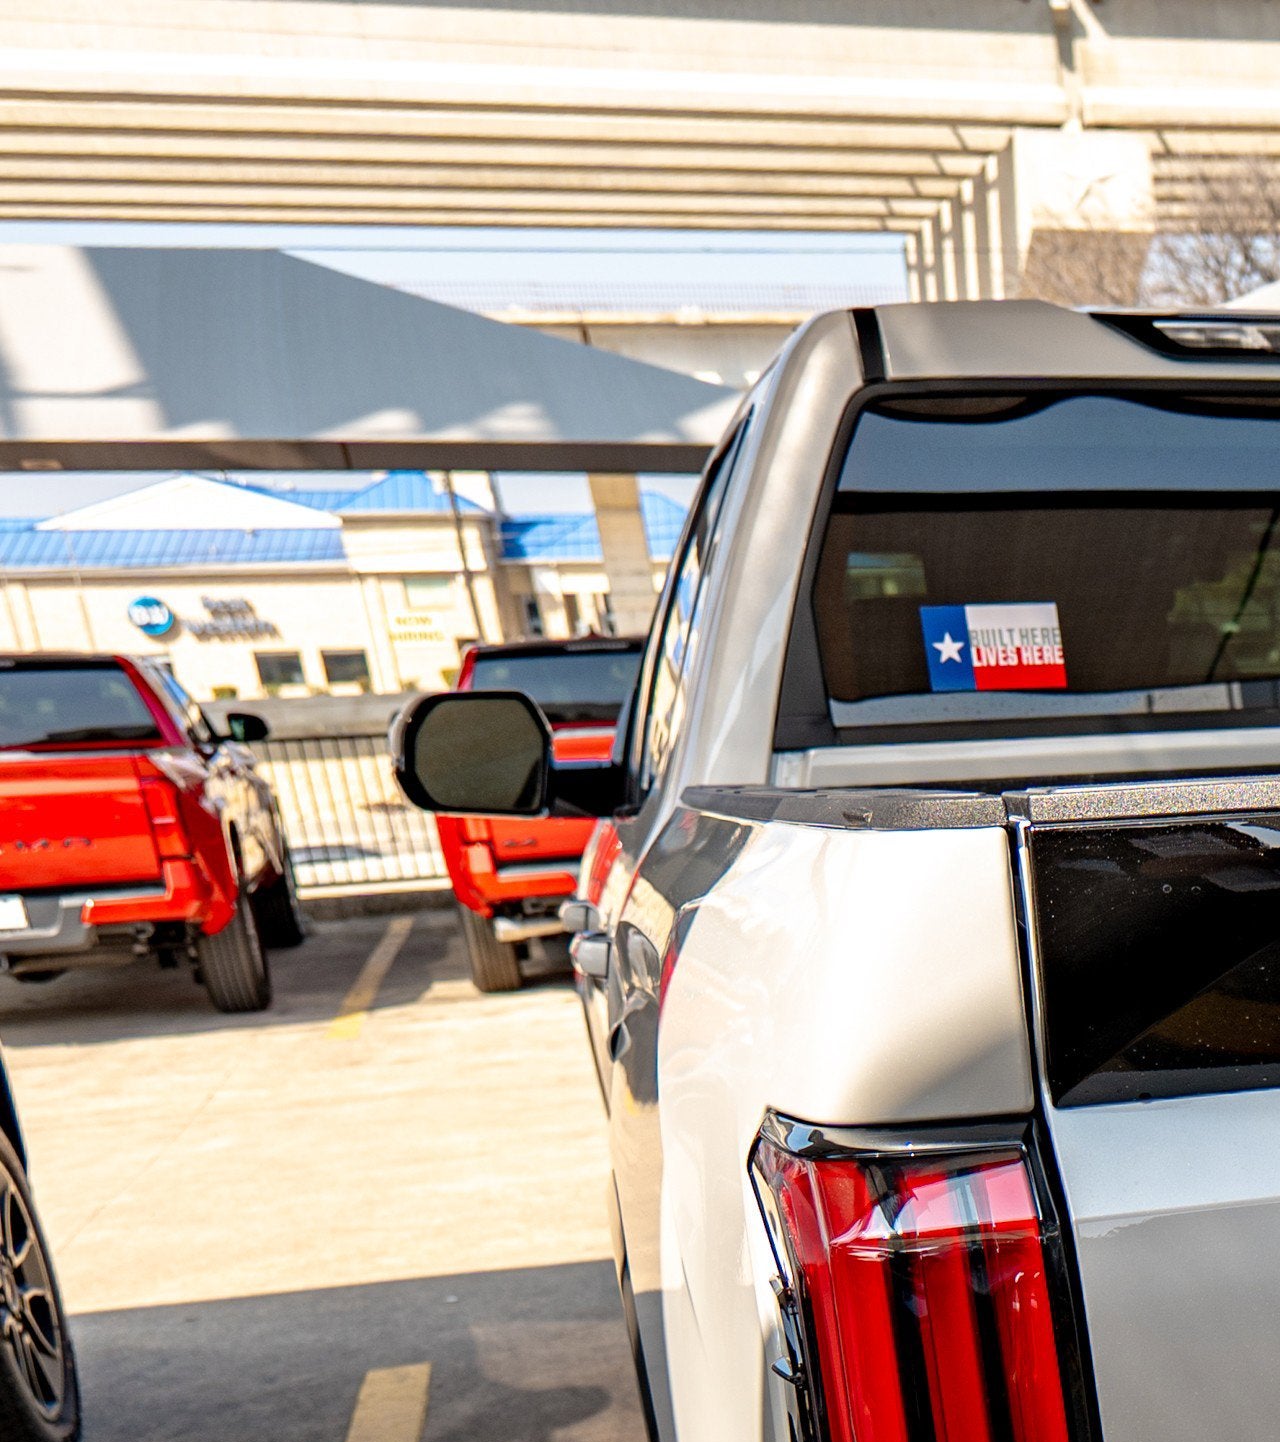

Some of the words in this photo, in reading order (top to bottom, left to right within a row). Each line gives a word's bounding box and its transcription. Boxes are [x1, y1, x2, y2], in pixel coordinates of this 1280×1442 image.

[970, 629, 1015, 648] BUILT
[1019, 627, 1062, 646] HERE
[972, 646, 1019, 667] LIVES
[1020, 645, 1065, 665] HERE
